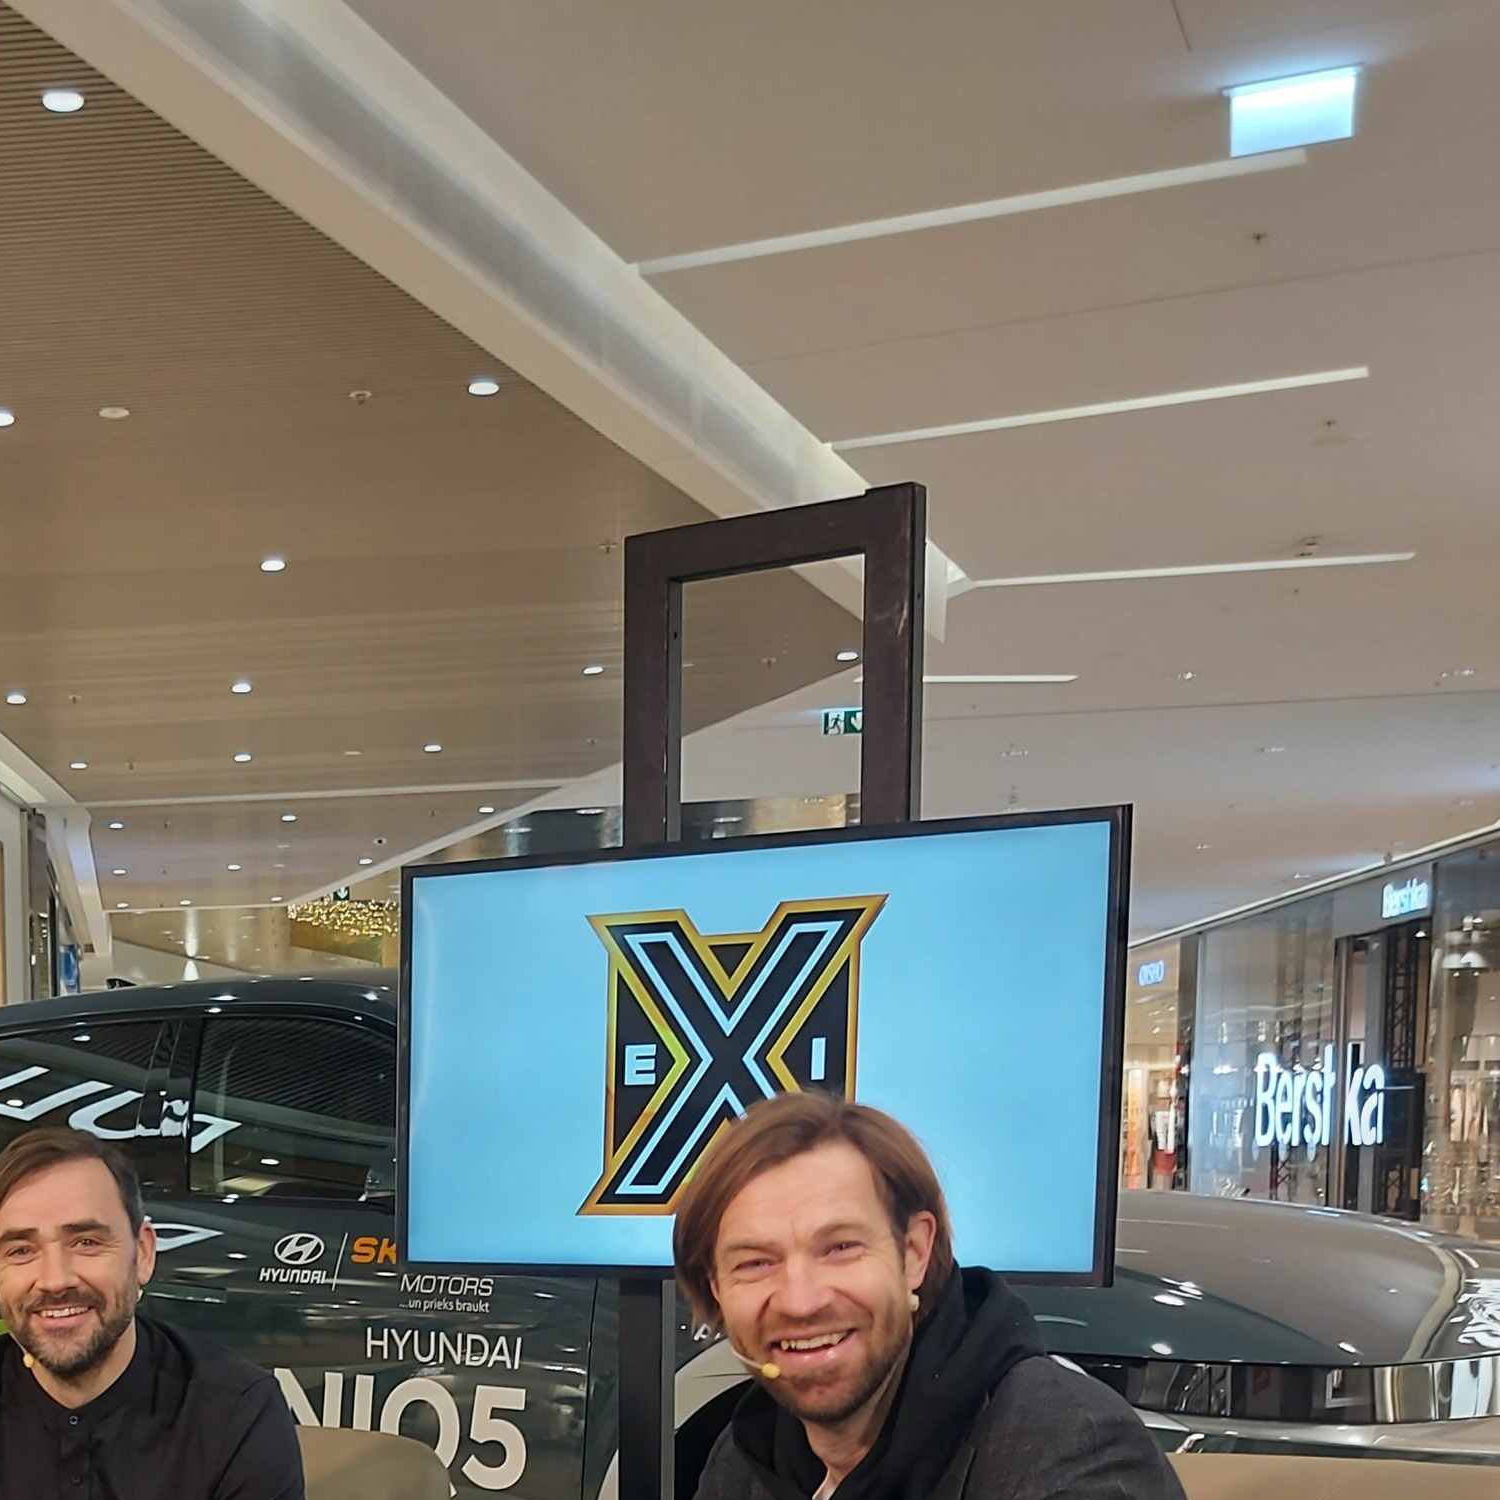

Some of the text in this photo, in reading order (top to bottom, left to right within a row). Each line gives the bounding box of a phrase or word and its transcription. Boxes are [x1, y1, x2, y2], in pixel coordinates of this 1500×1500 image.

[258, 1267, 328, 1285] HYUNDAI
[400, 1273, 494, 1297] MOTORS
[423, 1299, 454, 1312] prieks
[456, 1300, 490, 1314] braukt
[365, 1326, 523, 1370] HYUNDAI
